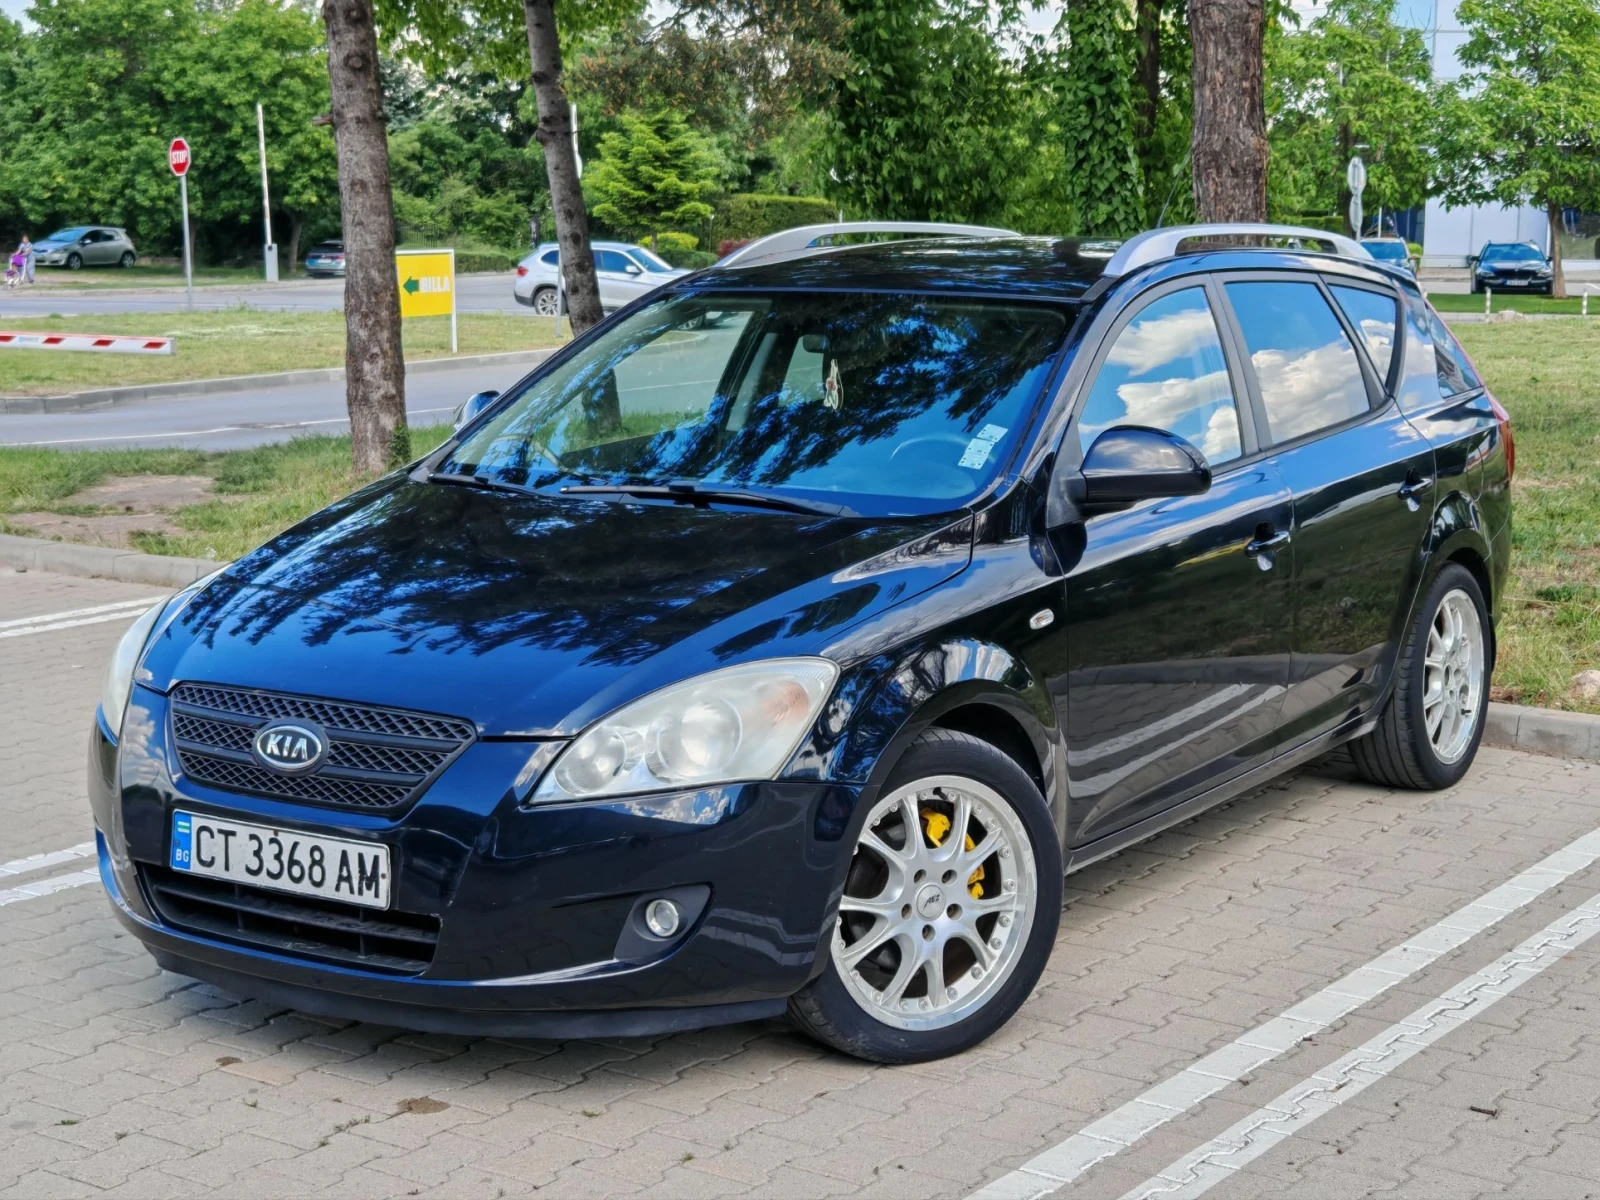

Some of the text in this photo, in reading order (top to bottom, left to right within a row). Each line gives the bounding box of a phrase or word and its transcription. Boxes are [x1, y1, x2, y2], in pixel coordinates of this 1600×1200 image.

[172, 150, 188, 164] STOP
[420, 276, 451, 293] BILLA
[266, 733, 308, 760] KIA
[175, 848, 190, 863] BG
[196, 825, 380, 899] CT 3368 AM
